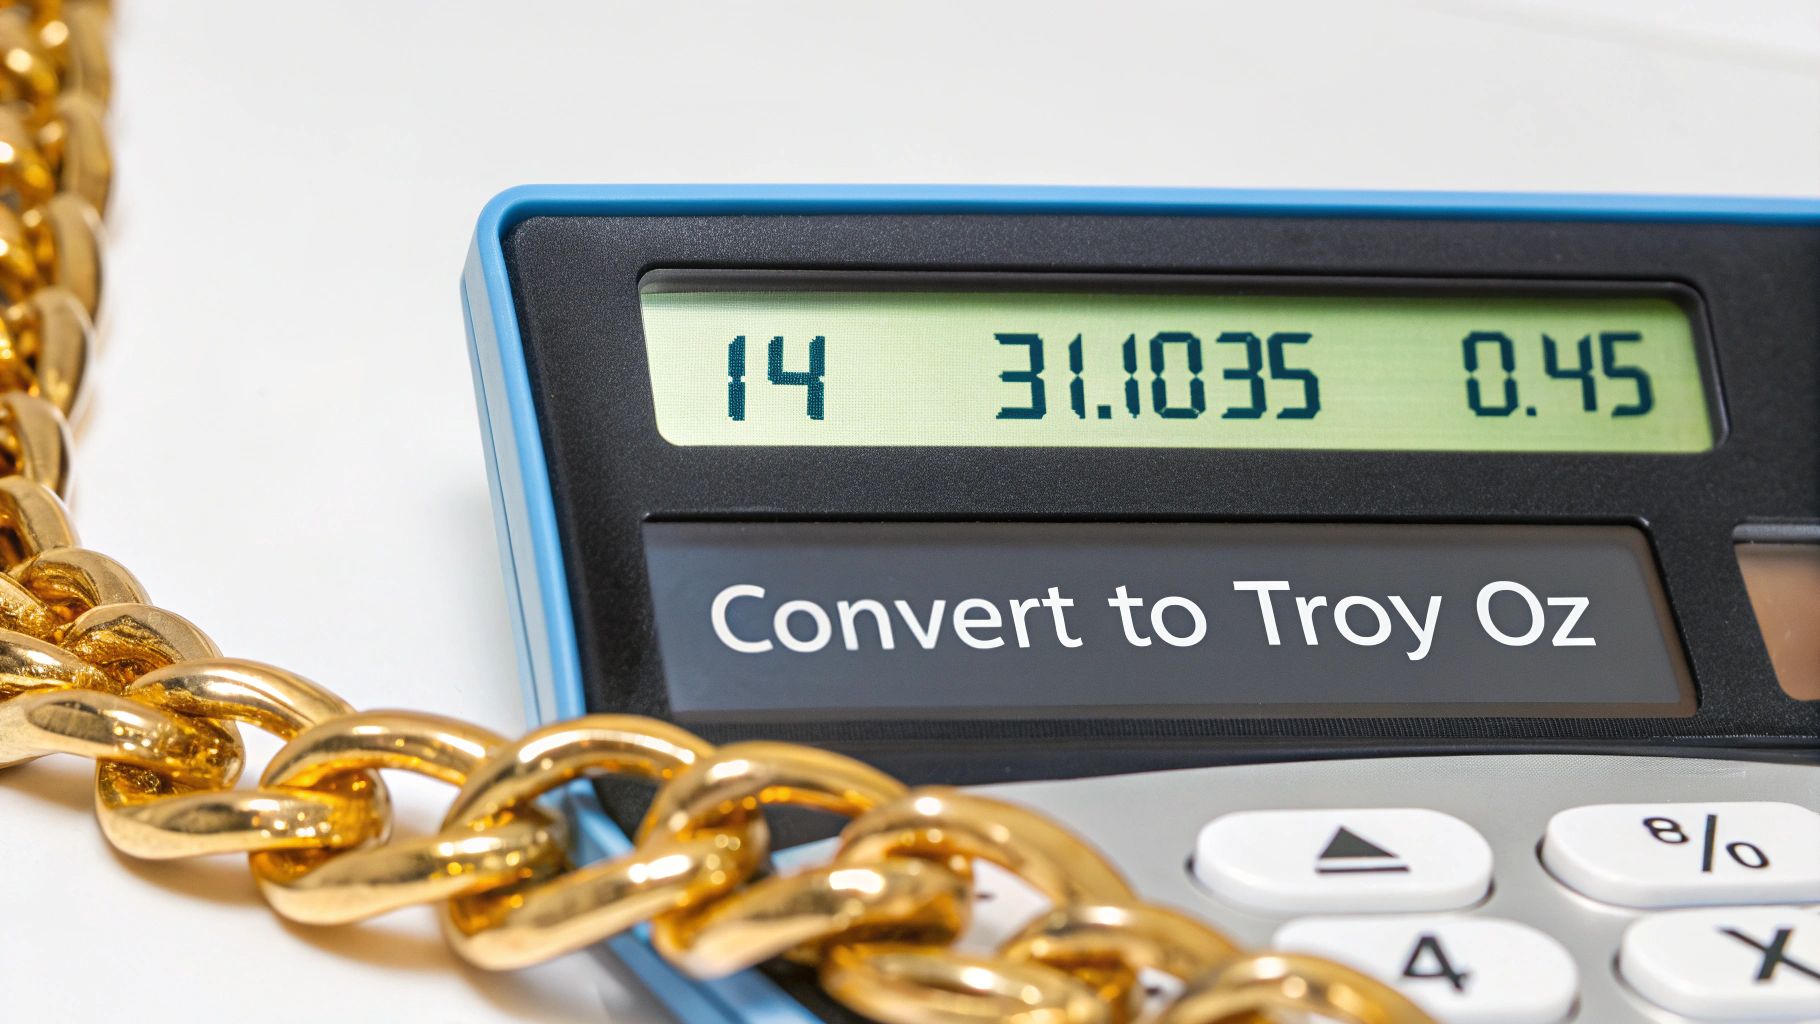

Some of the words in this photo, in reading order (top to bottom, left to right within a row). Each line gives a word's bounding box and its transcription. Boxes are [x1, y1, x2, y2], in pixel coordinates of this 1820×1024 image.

[727, 335, 826, 422] 14
[993, 331, 1321, 420] 31.1035
[1461, 330, 1656, 419] 0.45
[710, 584, 1084, 653] Convert
[1107, 585, 1207, 647] to
[1232, 580, 1443, 661] Troy
[1476, 580, 1597, 647] Oz
[1402, 936, 1469, 992] 4
